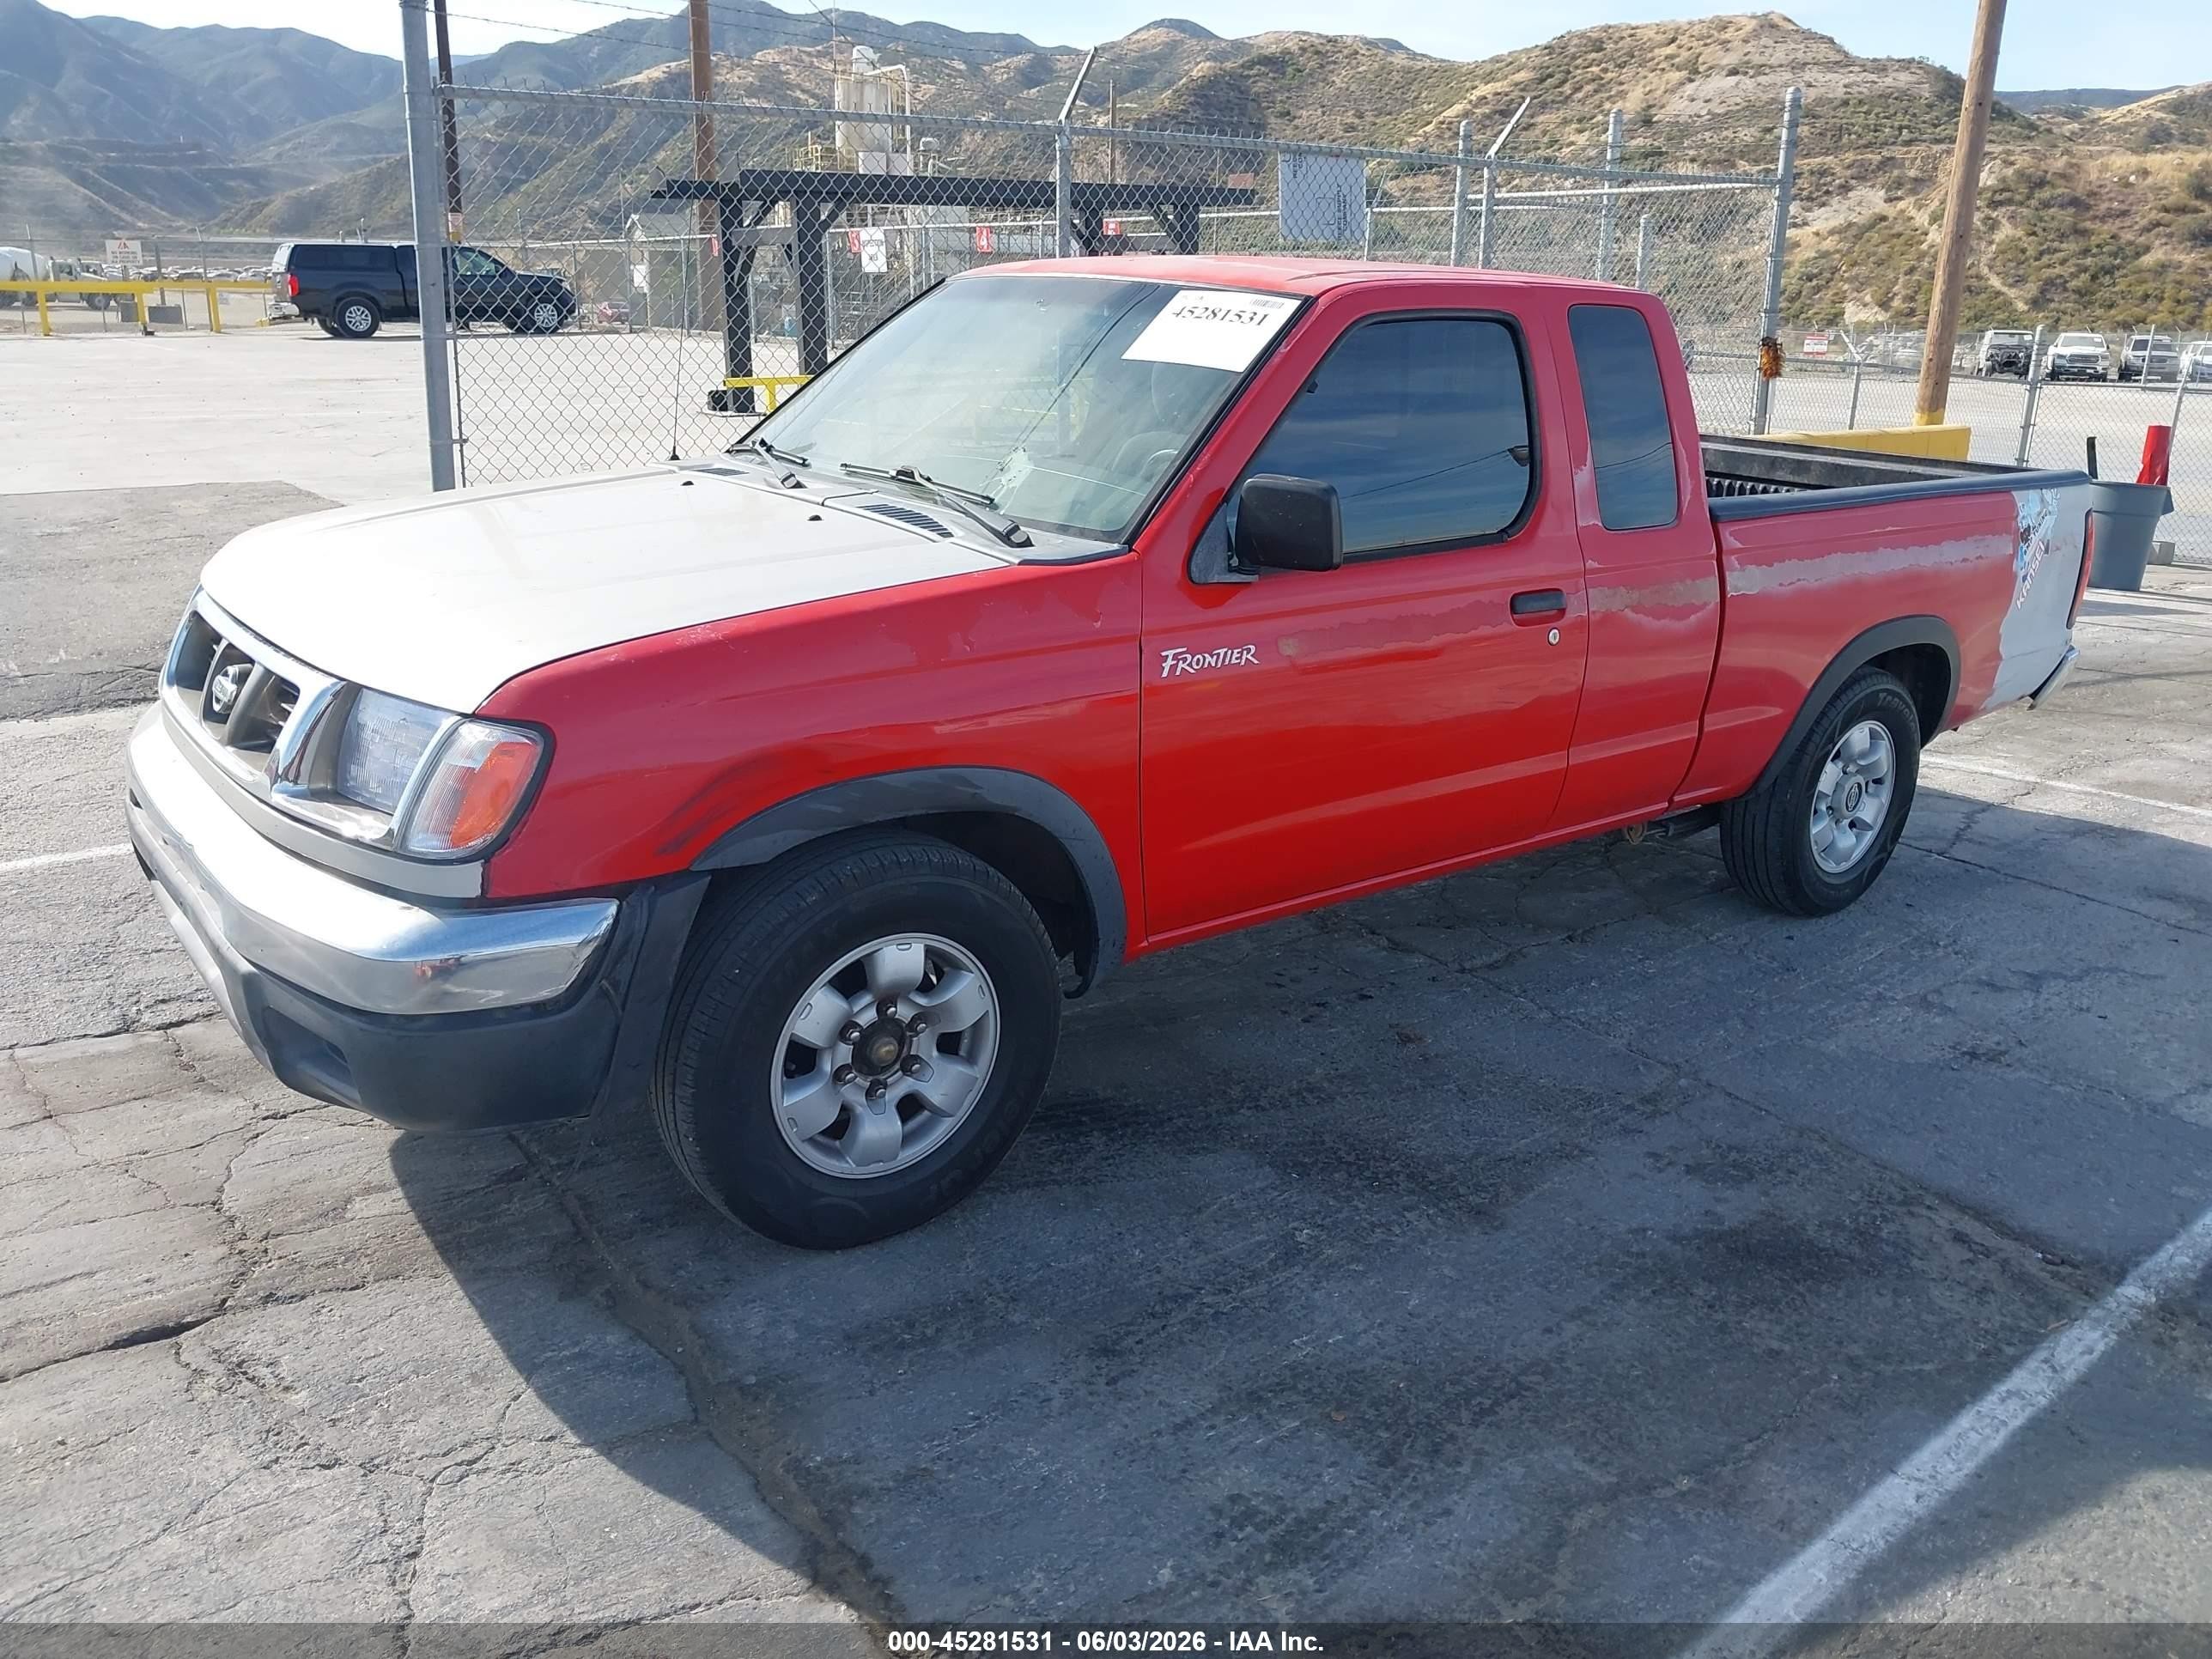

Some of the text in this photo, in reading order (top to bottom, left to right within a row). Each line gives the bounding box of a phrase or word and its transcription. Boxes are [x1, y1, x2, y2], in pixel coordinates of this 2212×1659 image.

[1172, 306, 1269, 326] 45281531
[2033, 508, 2047, 536] TUNING
[1159, 644, 1261, 678] FRONTIER
